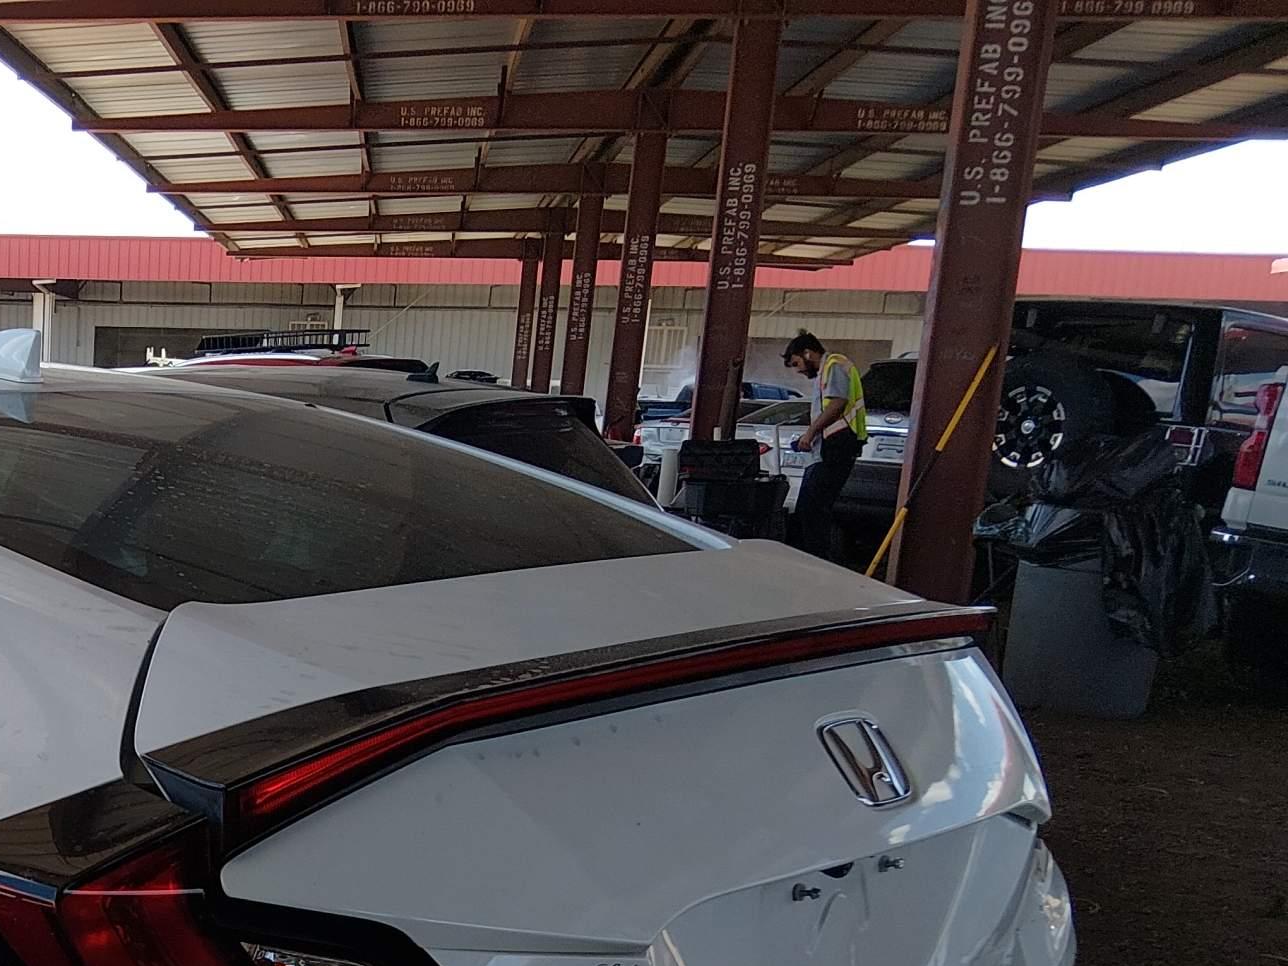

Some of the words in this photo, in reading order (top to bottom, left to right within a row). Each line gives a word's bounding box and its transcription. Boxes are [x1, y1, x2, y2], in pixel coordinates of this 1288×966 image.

[984, 0, 1009, 29] IN
[968, 43, 1002, 144] PREFAB
[728, 162, 743, 191] INC.
[960, 158, 987, 206] U.S.
[721, 198, 739, 255] PREFAB
[732, 163, 757, 288] 1-866-799-0969
[624, 259, 637, 299] PREFAB
[717, 261, 733, 290] U.S.
